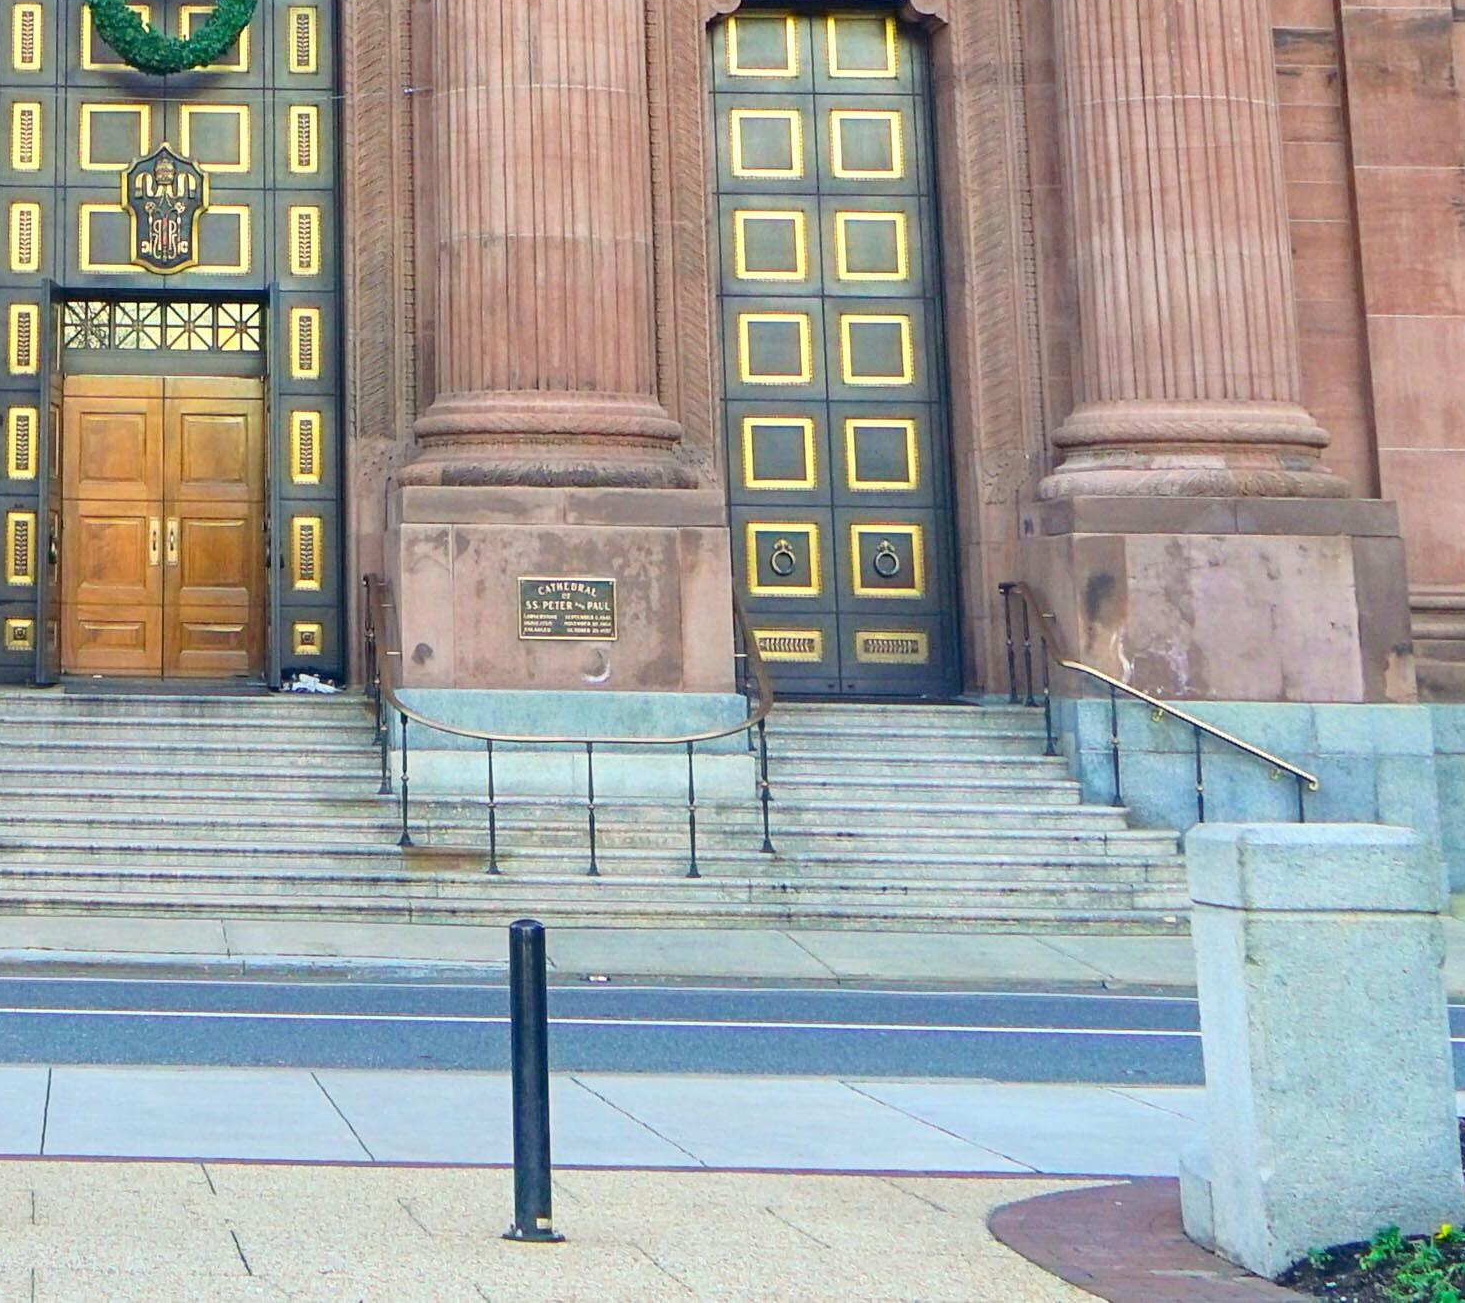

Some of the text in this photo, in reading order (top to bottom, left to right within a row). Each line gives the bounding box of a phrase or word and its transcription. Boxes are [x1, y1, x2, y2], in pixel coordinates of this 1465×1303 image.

[538, 582, 596, 597] CATHEDRAL
[542, 600, 573, 611] PETER
[587, 601, 610, 611] PAUL
